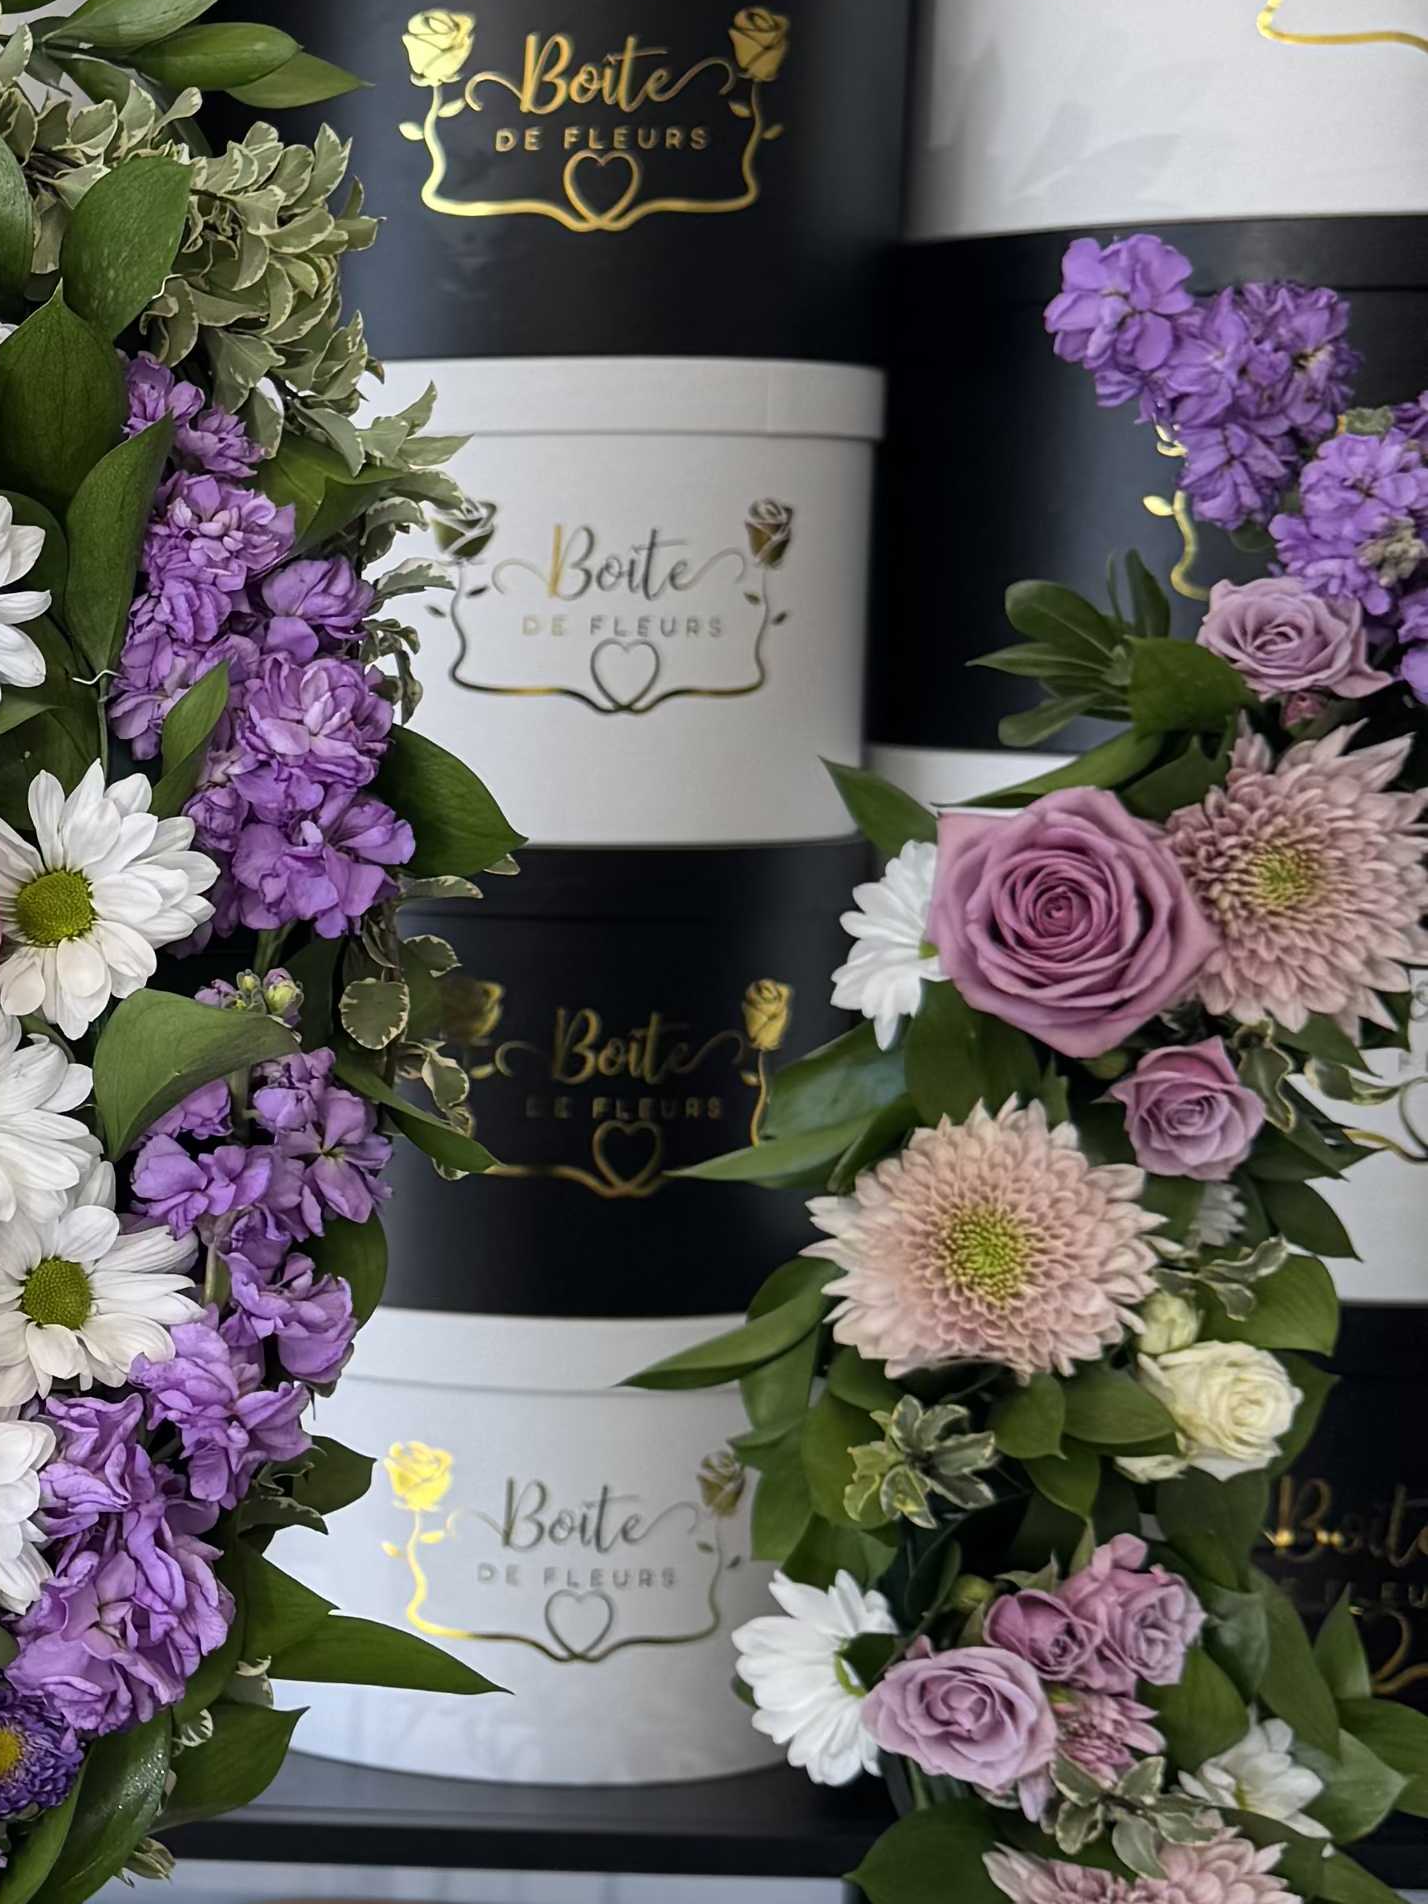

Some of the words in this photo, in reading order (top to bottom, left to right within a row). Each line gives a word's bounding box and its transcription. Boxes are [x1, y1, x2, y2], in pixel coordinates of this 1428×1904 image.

[496, 127, 539, 153] DE
[563, 126, 709, 151] FLEURS
[522, 614, 566, 636] DE
[589, 614, 723, 639] FLEURS
[592, 1098, 723, 1119] FLEURS
[477, 1564, 519, 1584] DE
[544, 1565, 677, 1588] FLEURS
